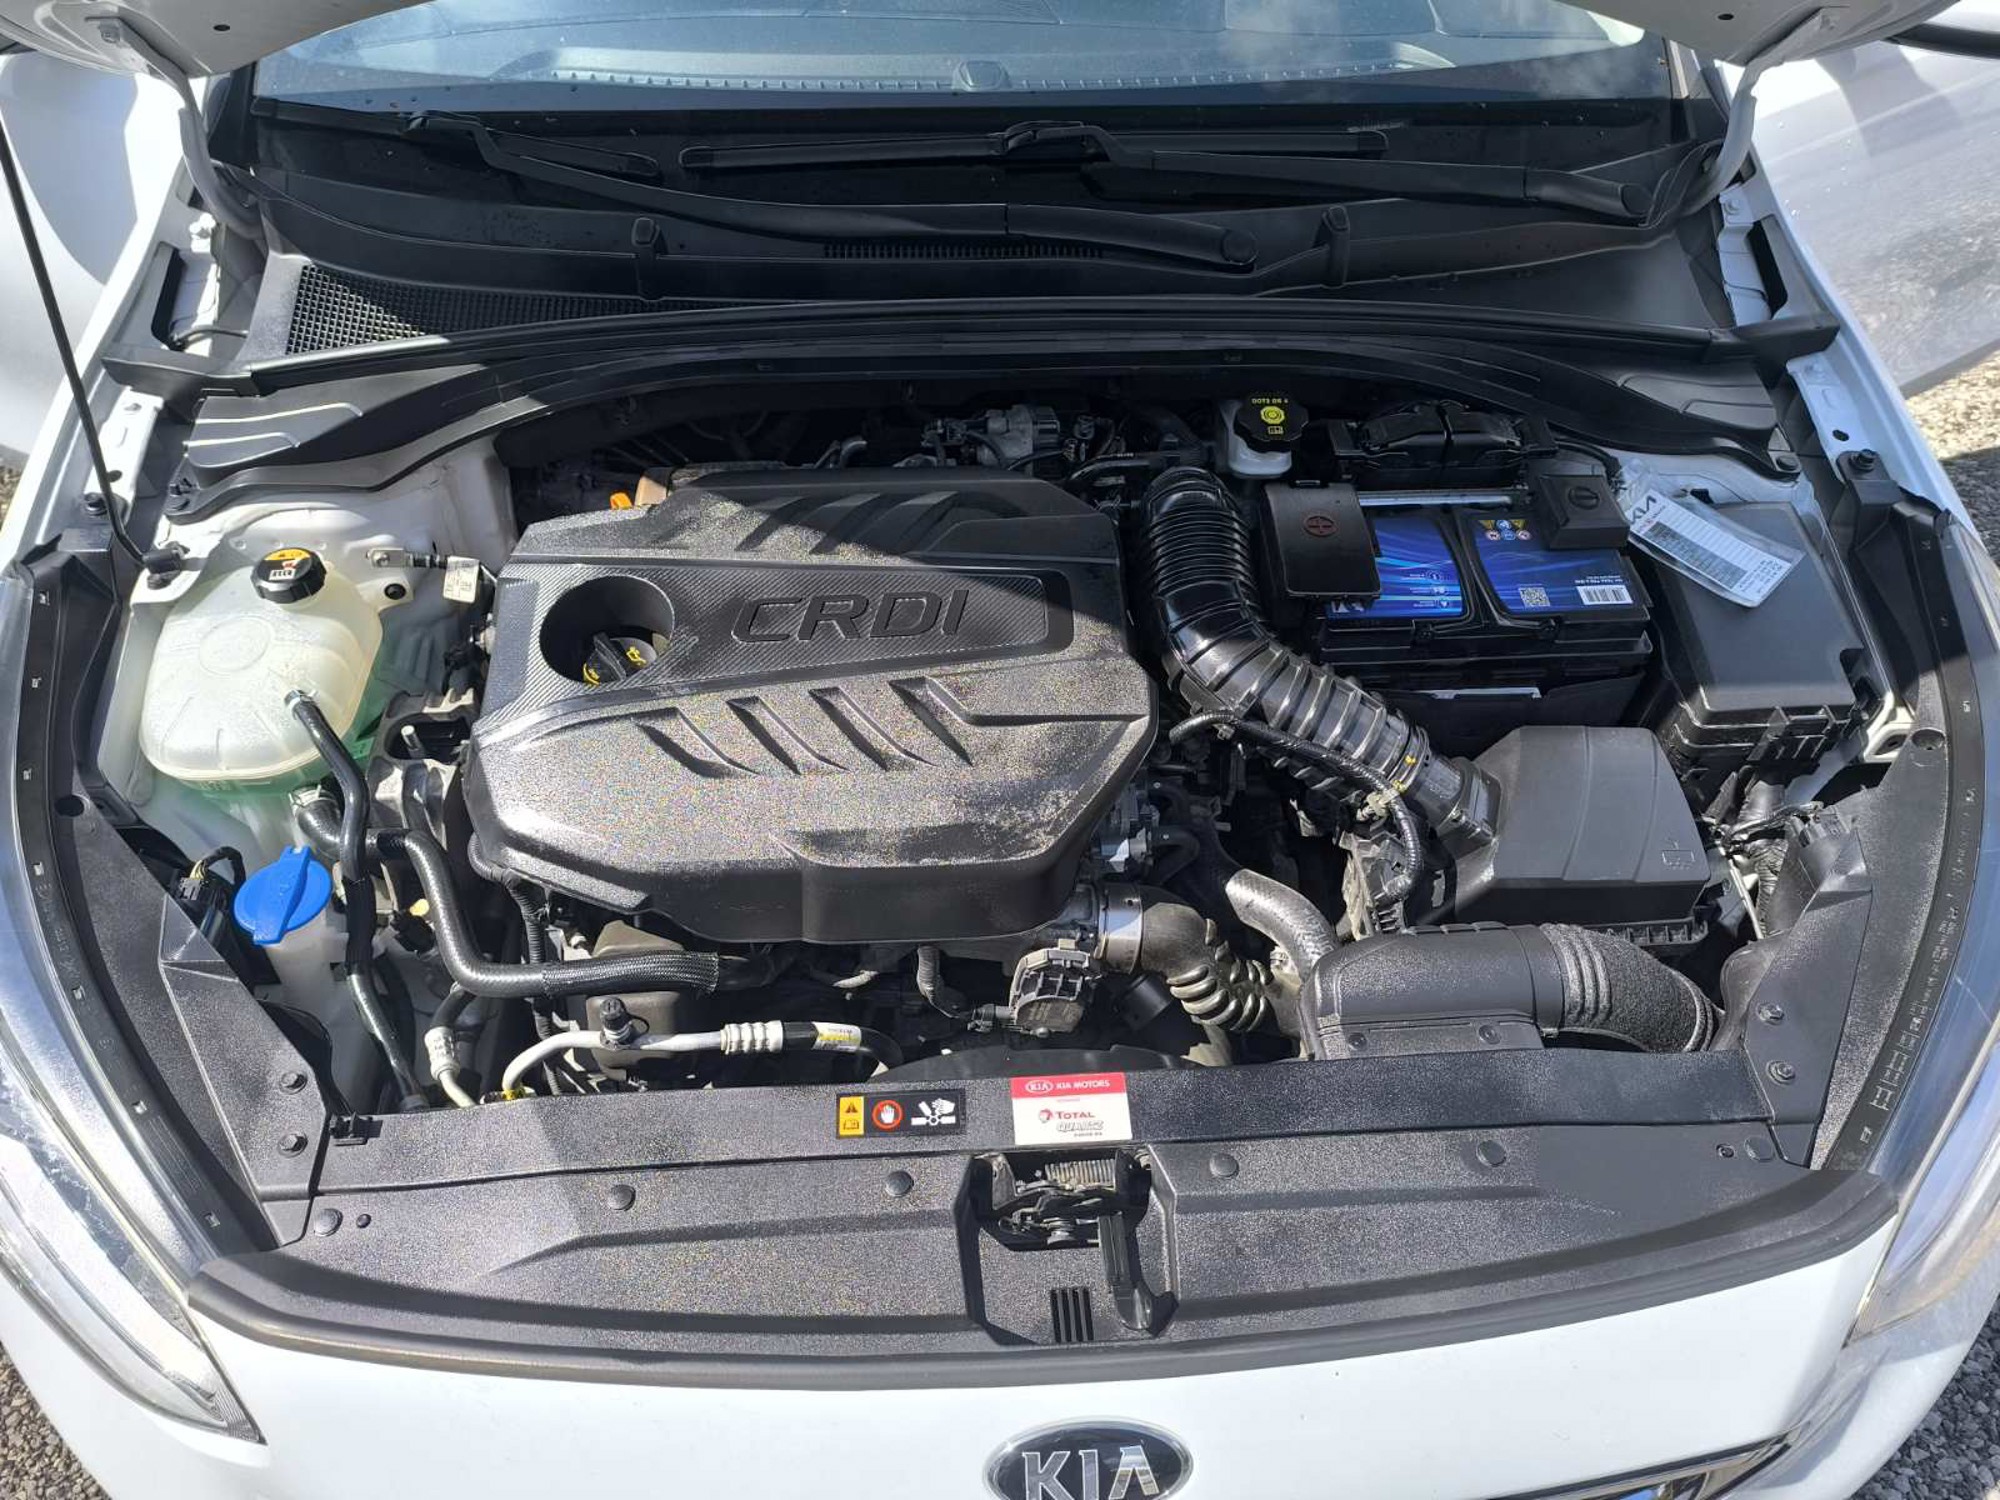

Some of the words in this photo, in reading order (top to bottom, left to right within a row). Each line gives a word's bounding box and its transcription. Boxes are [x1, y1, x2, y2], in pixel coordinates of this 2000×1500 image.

[731, 589, 970, 643] CRDI
[1028, 1081, 1050, 1092] KIA
[1056, 1082, 1072, 1090] KIA
[1073, 1080, 1111, 1090] MOTORS
[1055, 1110, 1096, 1120] TOTAL
[1022, 1445, 1160, 1500] KIA
